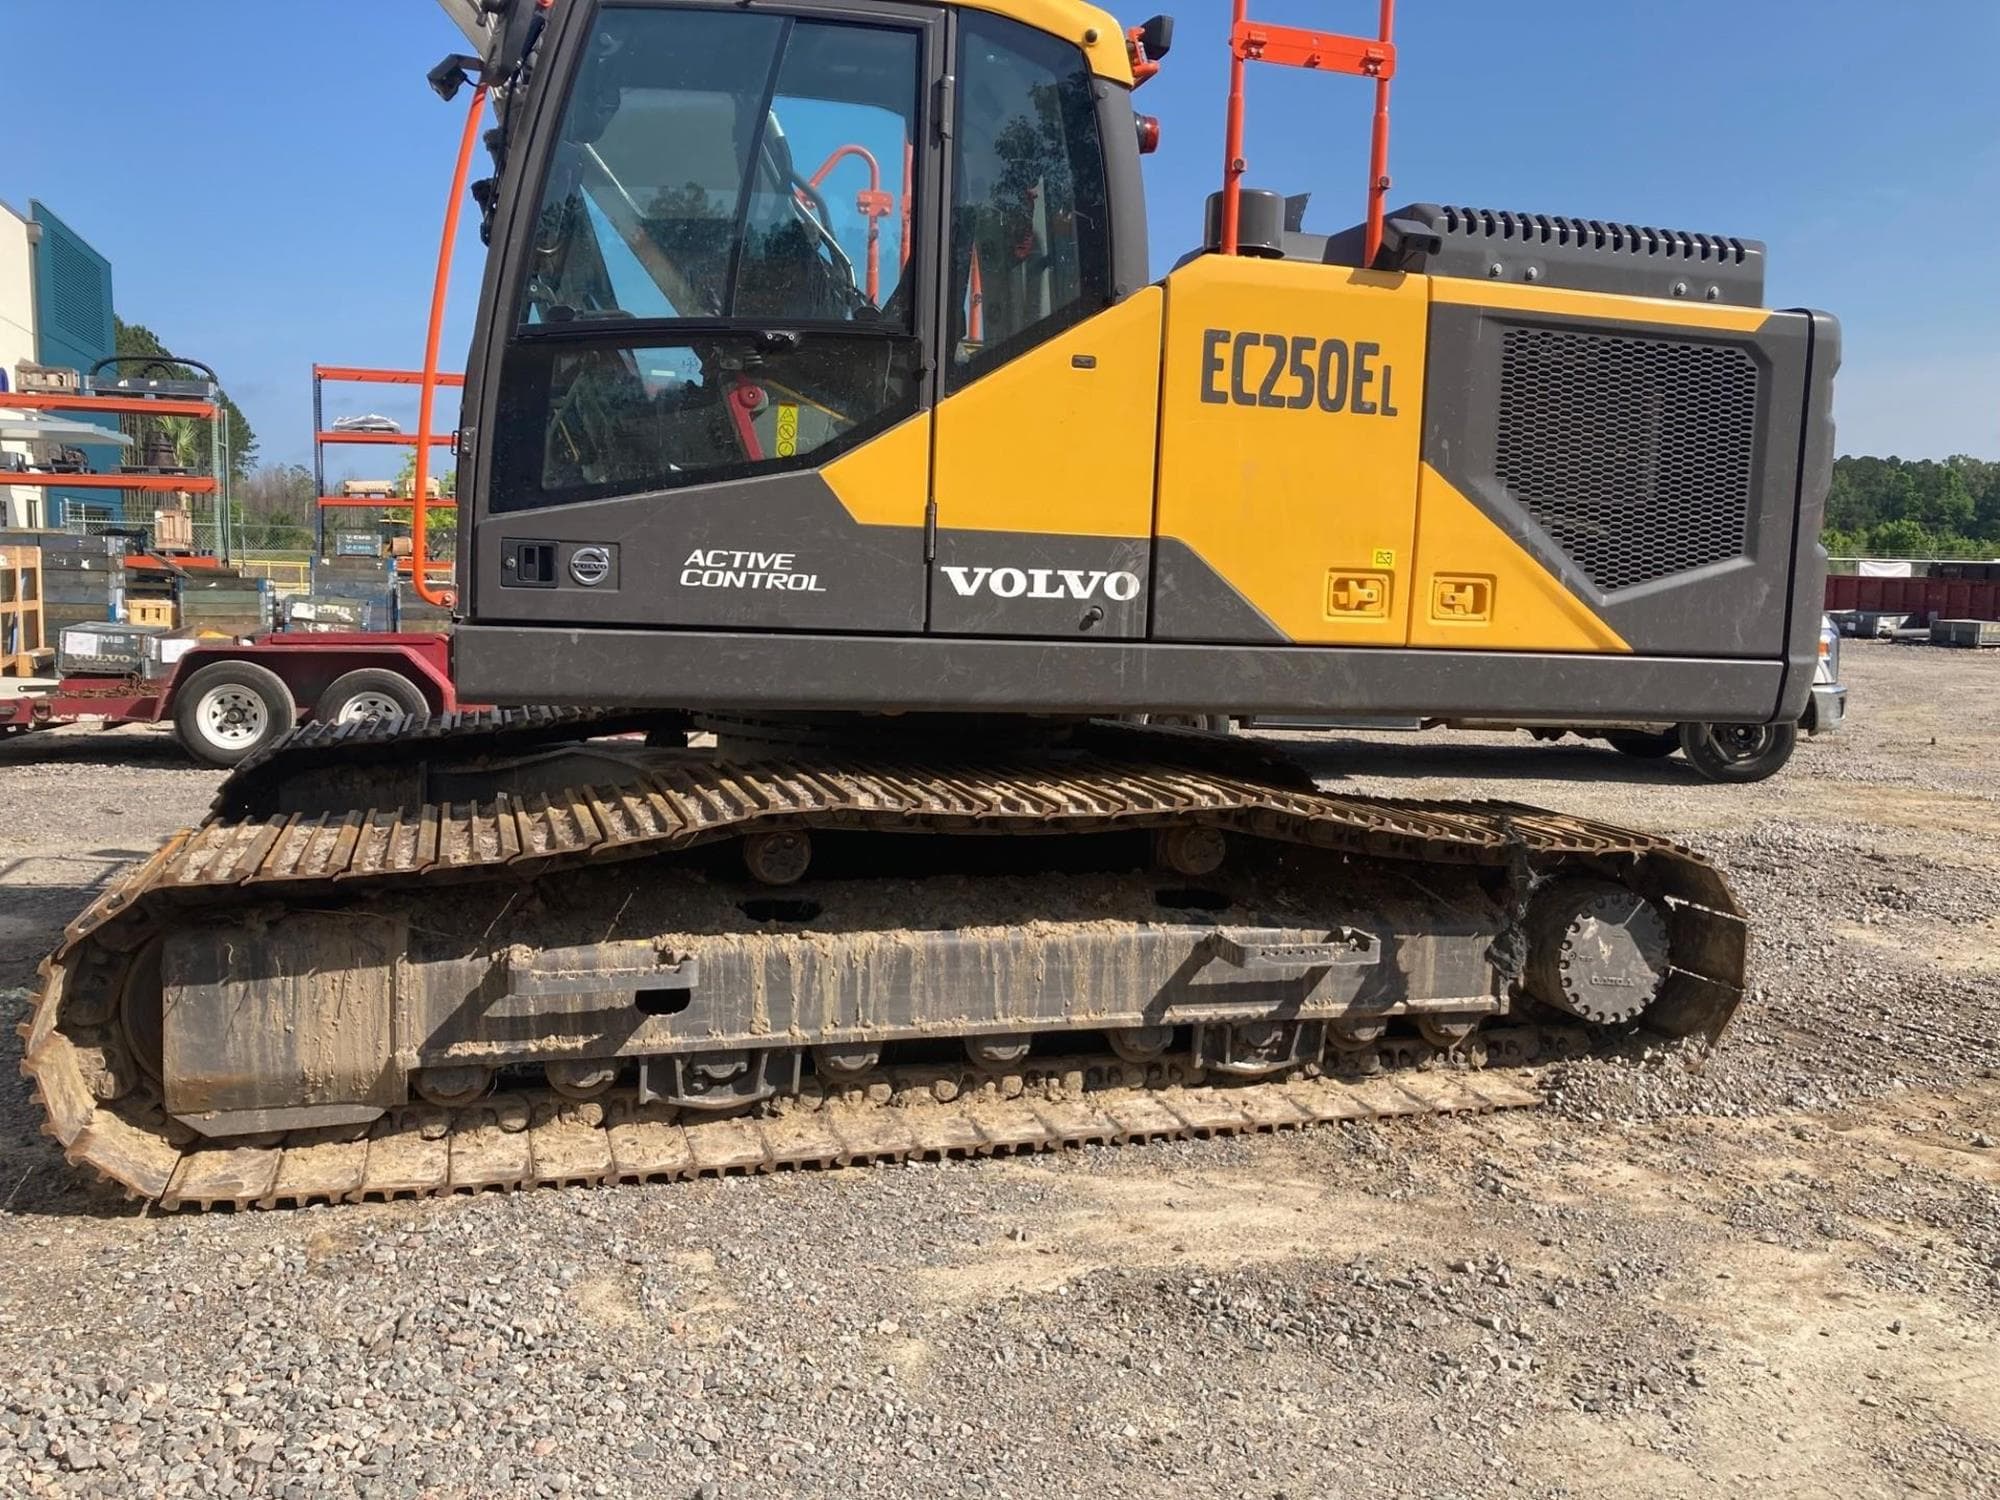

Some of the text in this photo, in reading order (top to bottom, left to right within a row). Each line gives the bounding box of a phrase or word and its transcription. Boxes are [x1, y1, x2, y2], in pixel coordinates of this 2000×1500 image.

[1200, 329, 1398, 417] EC250EL
[572, 562, 608, 570] VOLVO
[684, 549, 796, 570] ACTIVE
[680, 569, 827, 592] CONTROL
[940, 566, 1141, 601] VOLVO
[72, 653, 131, 663] VOLVO
